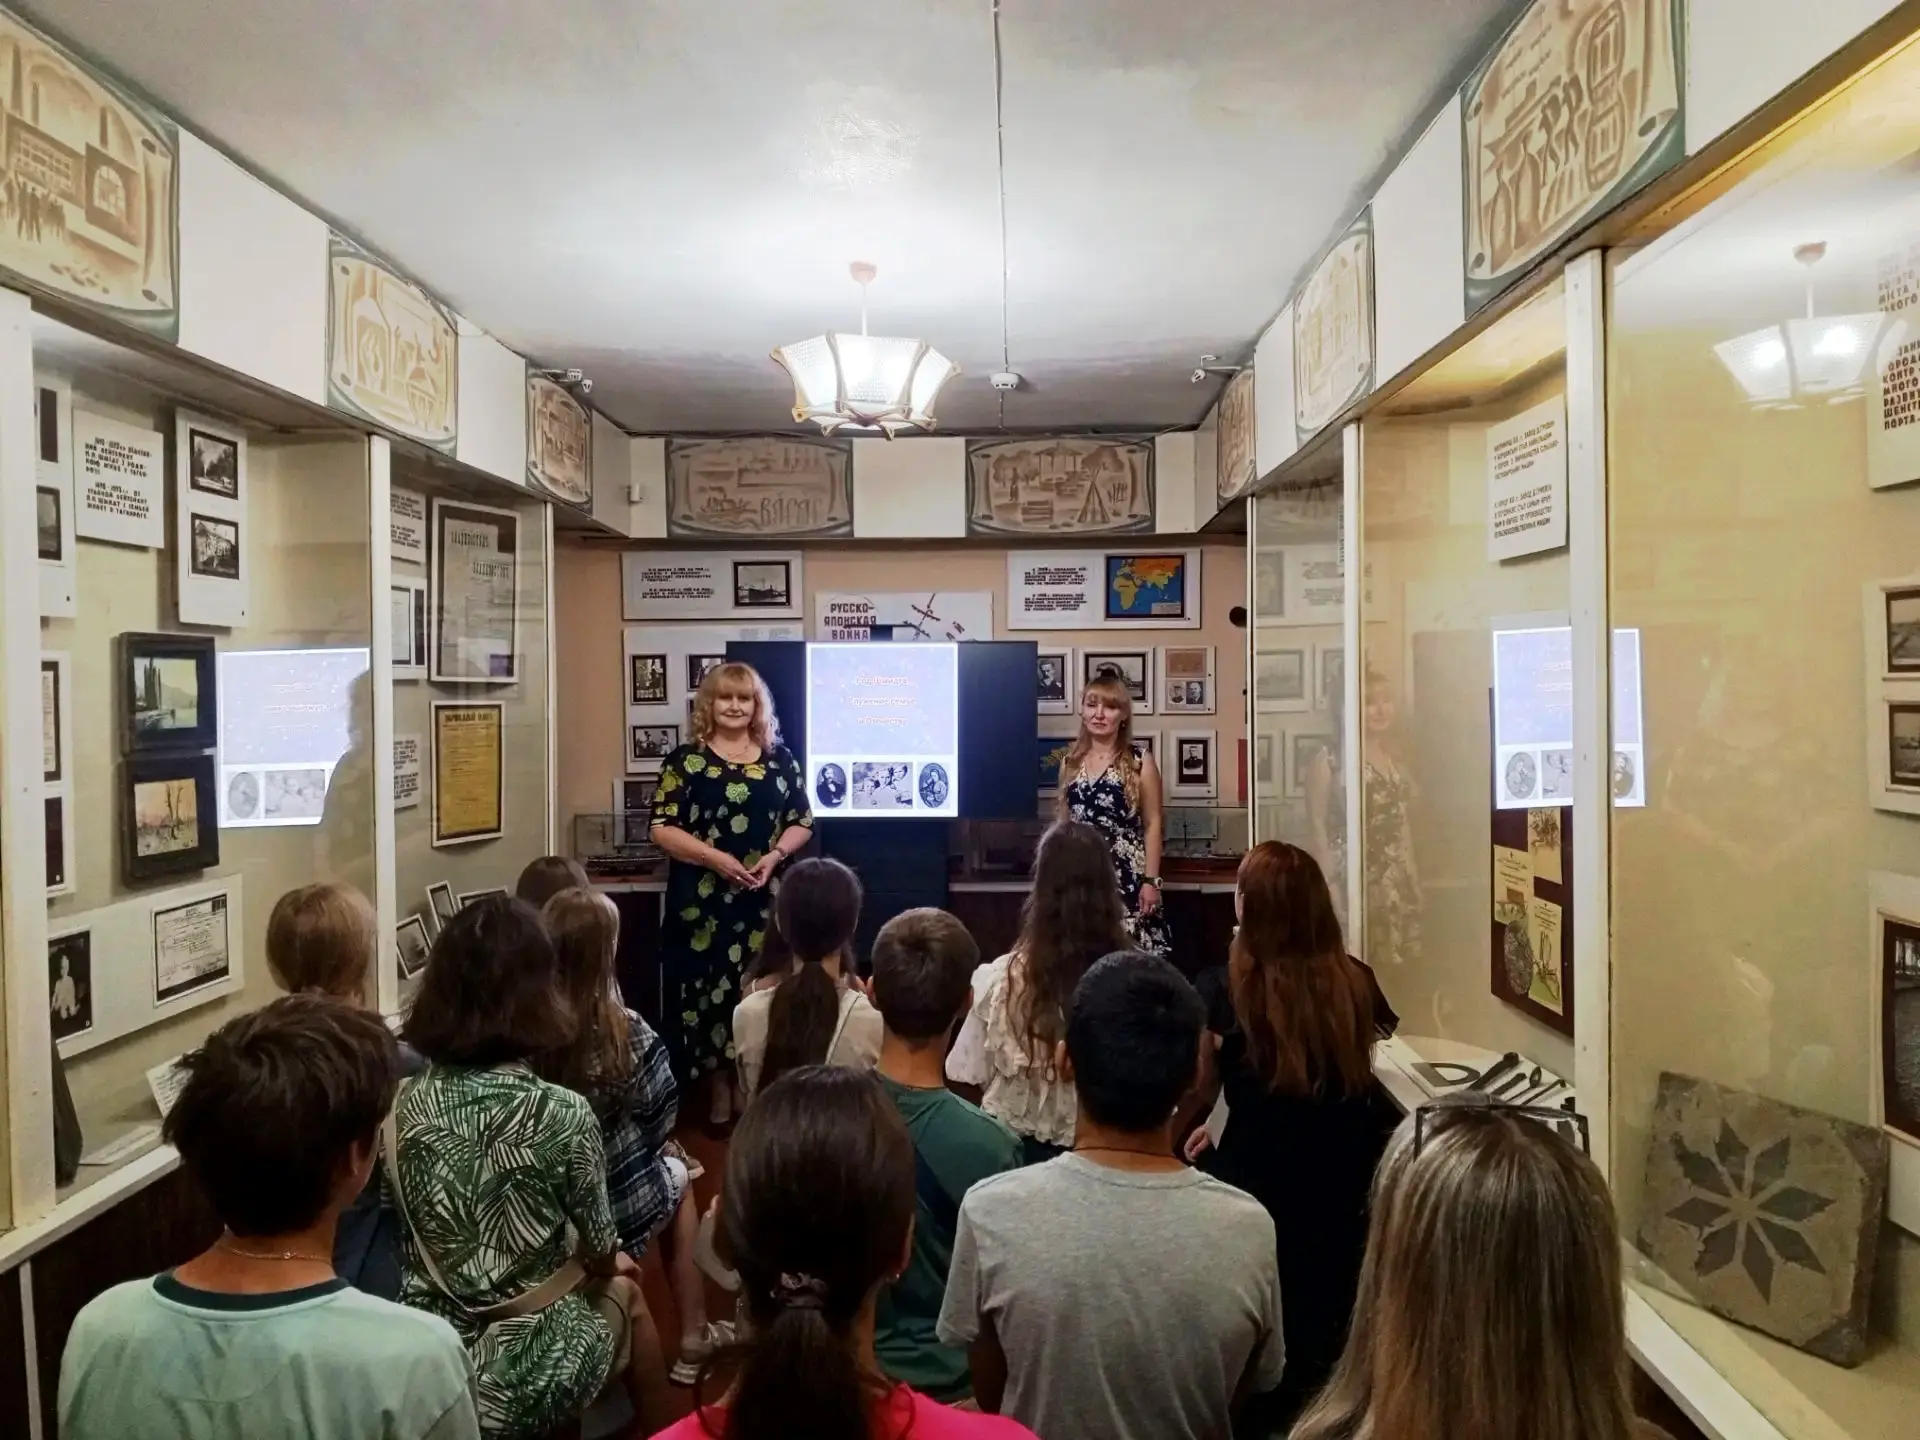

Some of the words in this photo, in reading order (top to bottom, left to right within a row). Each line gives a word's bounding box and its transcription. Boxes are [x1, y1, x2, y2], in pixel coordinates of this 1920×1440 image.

[1880, 293, 1918, 312] ЬКОГО
[1883, 377, 1919, 396] МНОГО
[830, 603, 875, 614] РУССКО-
[824, 616, 876, 627] ЯПОНСКАЯ
